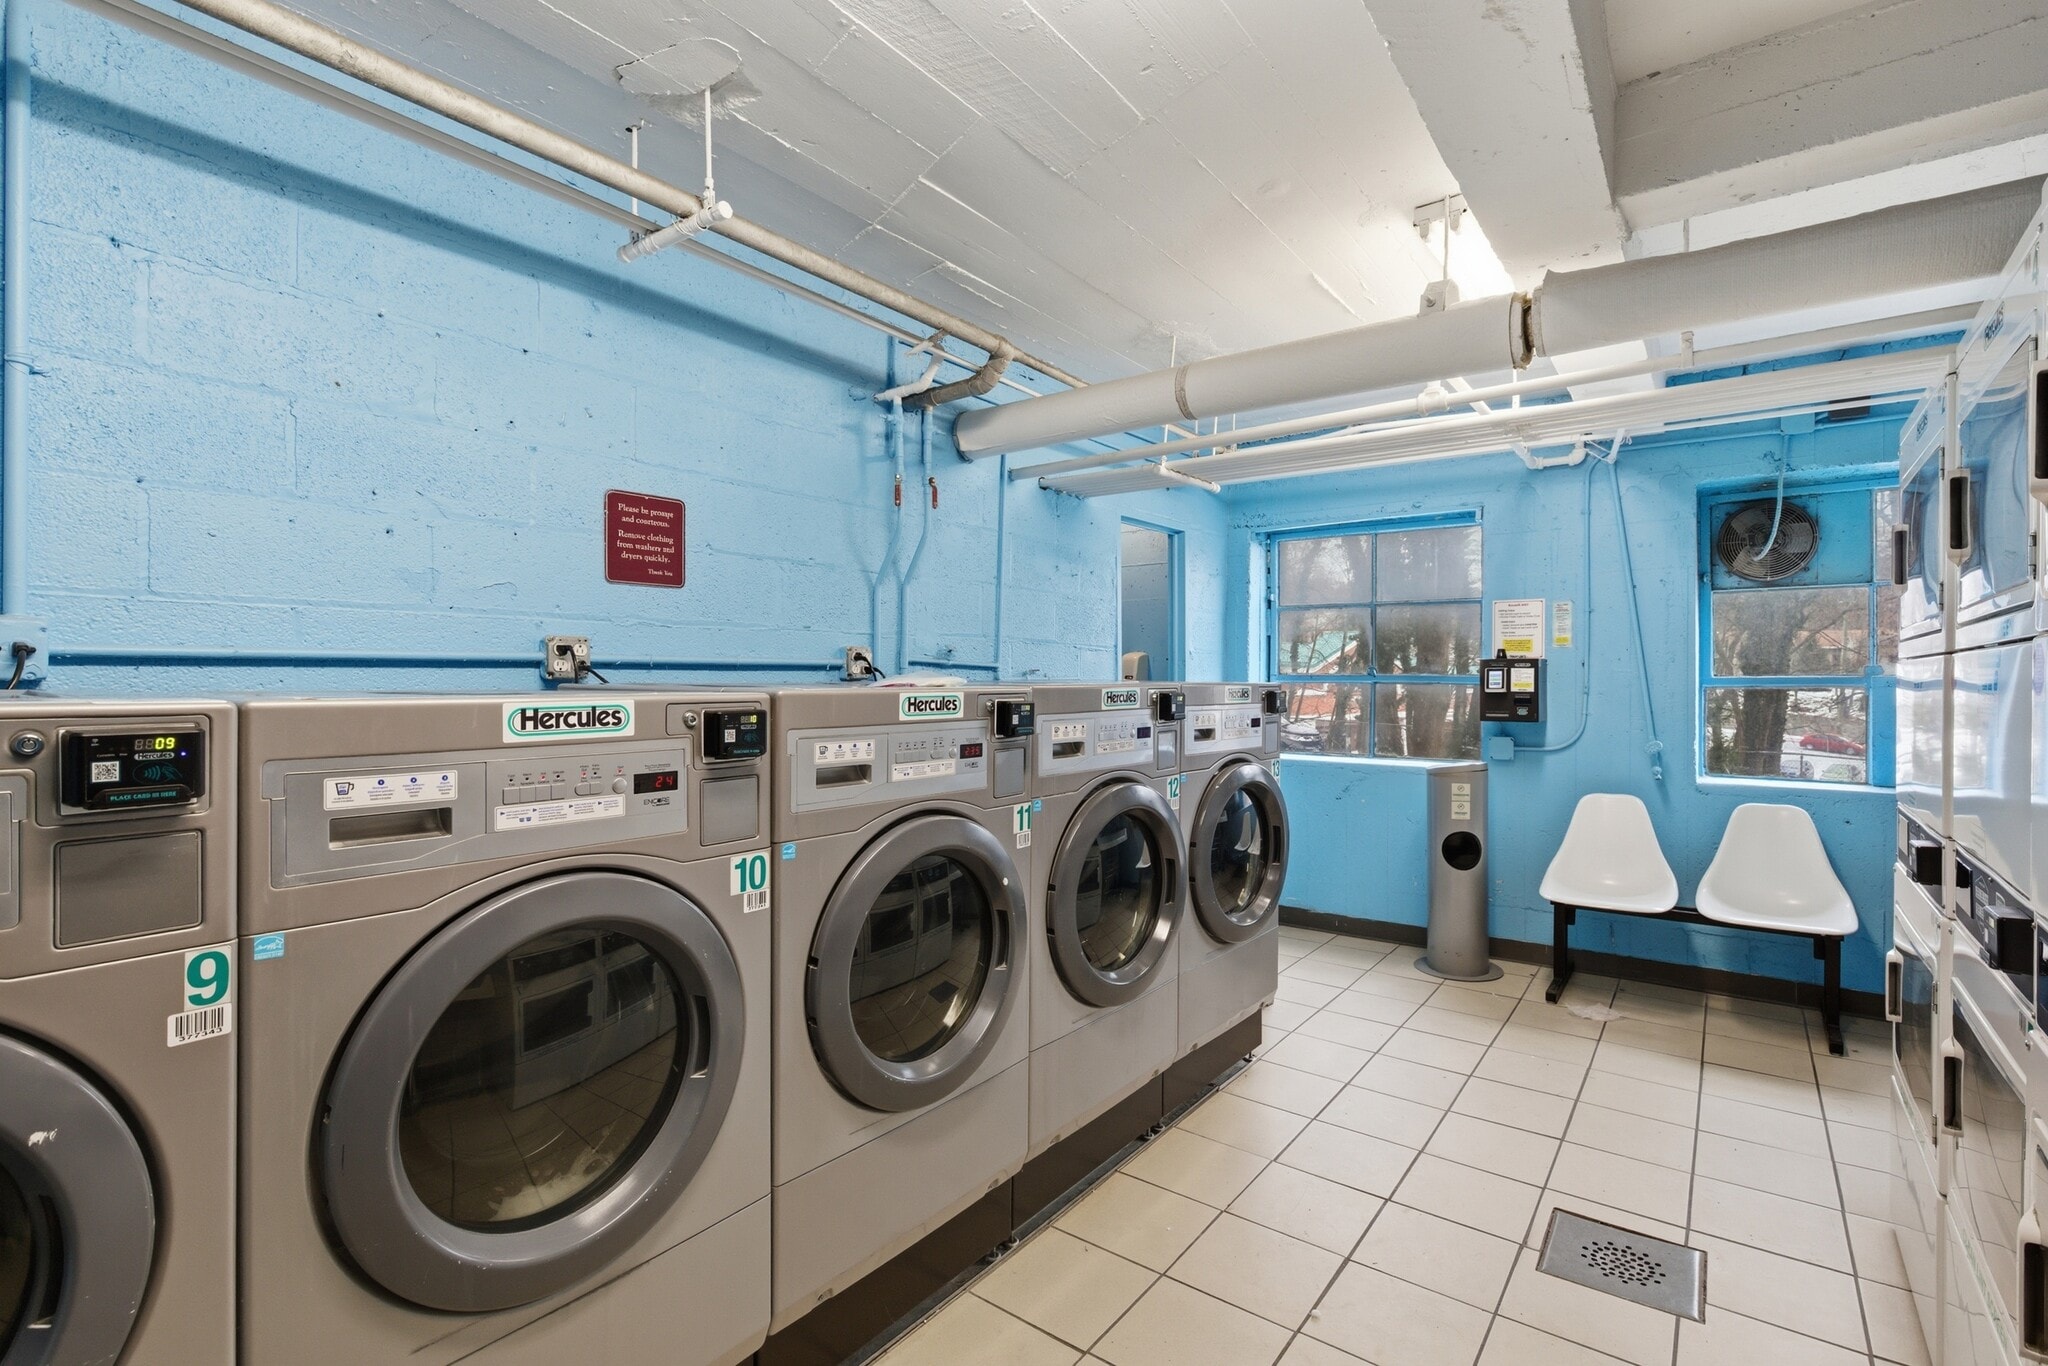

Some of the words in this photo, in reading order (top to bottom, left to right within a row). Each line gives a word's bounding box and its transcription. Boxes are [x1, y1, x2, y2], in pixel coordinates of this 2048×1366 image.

[618, 502, 639, 513] Please
[641, 506, 649, 515] be
[650, 510, 674, 519] prompt
[621, 515, 634, 523] and
[635, 518, 670, 528] courteous.
[618, 529, 646, 540] Remove
[647, 533, 674, 545] clothing
[616, 540, 634, 548] from
[635, 543, 661, 552] washers
[621, 551, 643, 560] dryers
[644, 555, 671, 564] quickly.
[648, 568, 663, 576] Thank
[907, 697, 958, 713] Hercules
[1106, 692, 1137, 704] Hercules
[520, 706, 622, 730] Hercules
[1272, 760, 1280, 777] 13
[1168, 777, 1179, 798] 12
[1017, 805, 1031, 831] 11
[735, 855, 766, 892] 10
[187, 951, 229, 1006] 9
[179, 1028, 223, 1042] 377343
